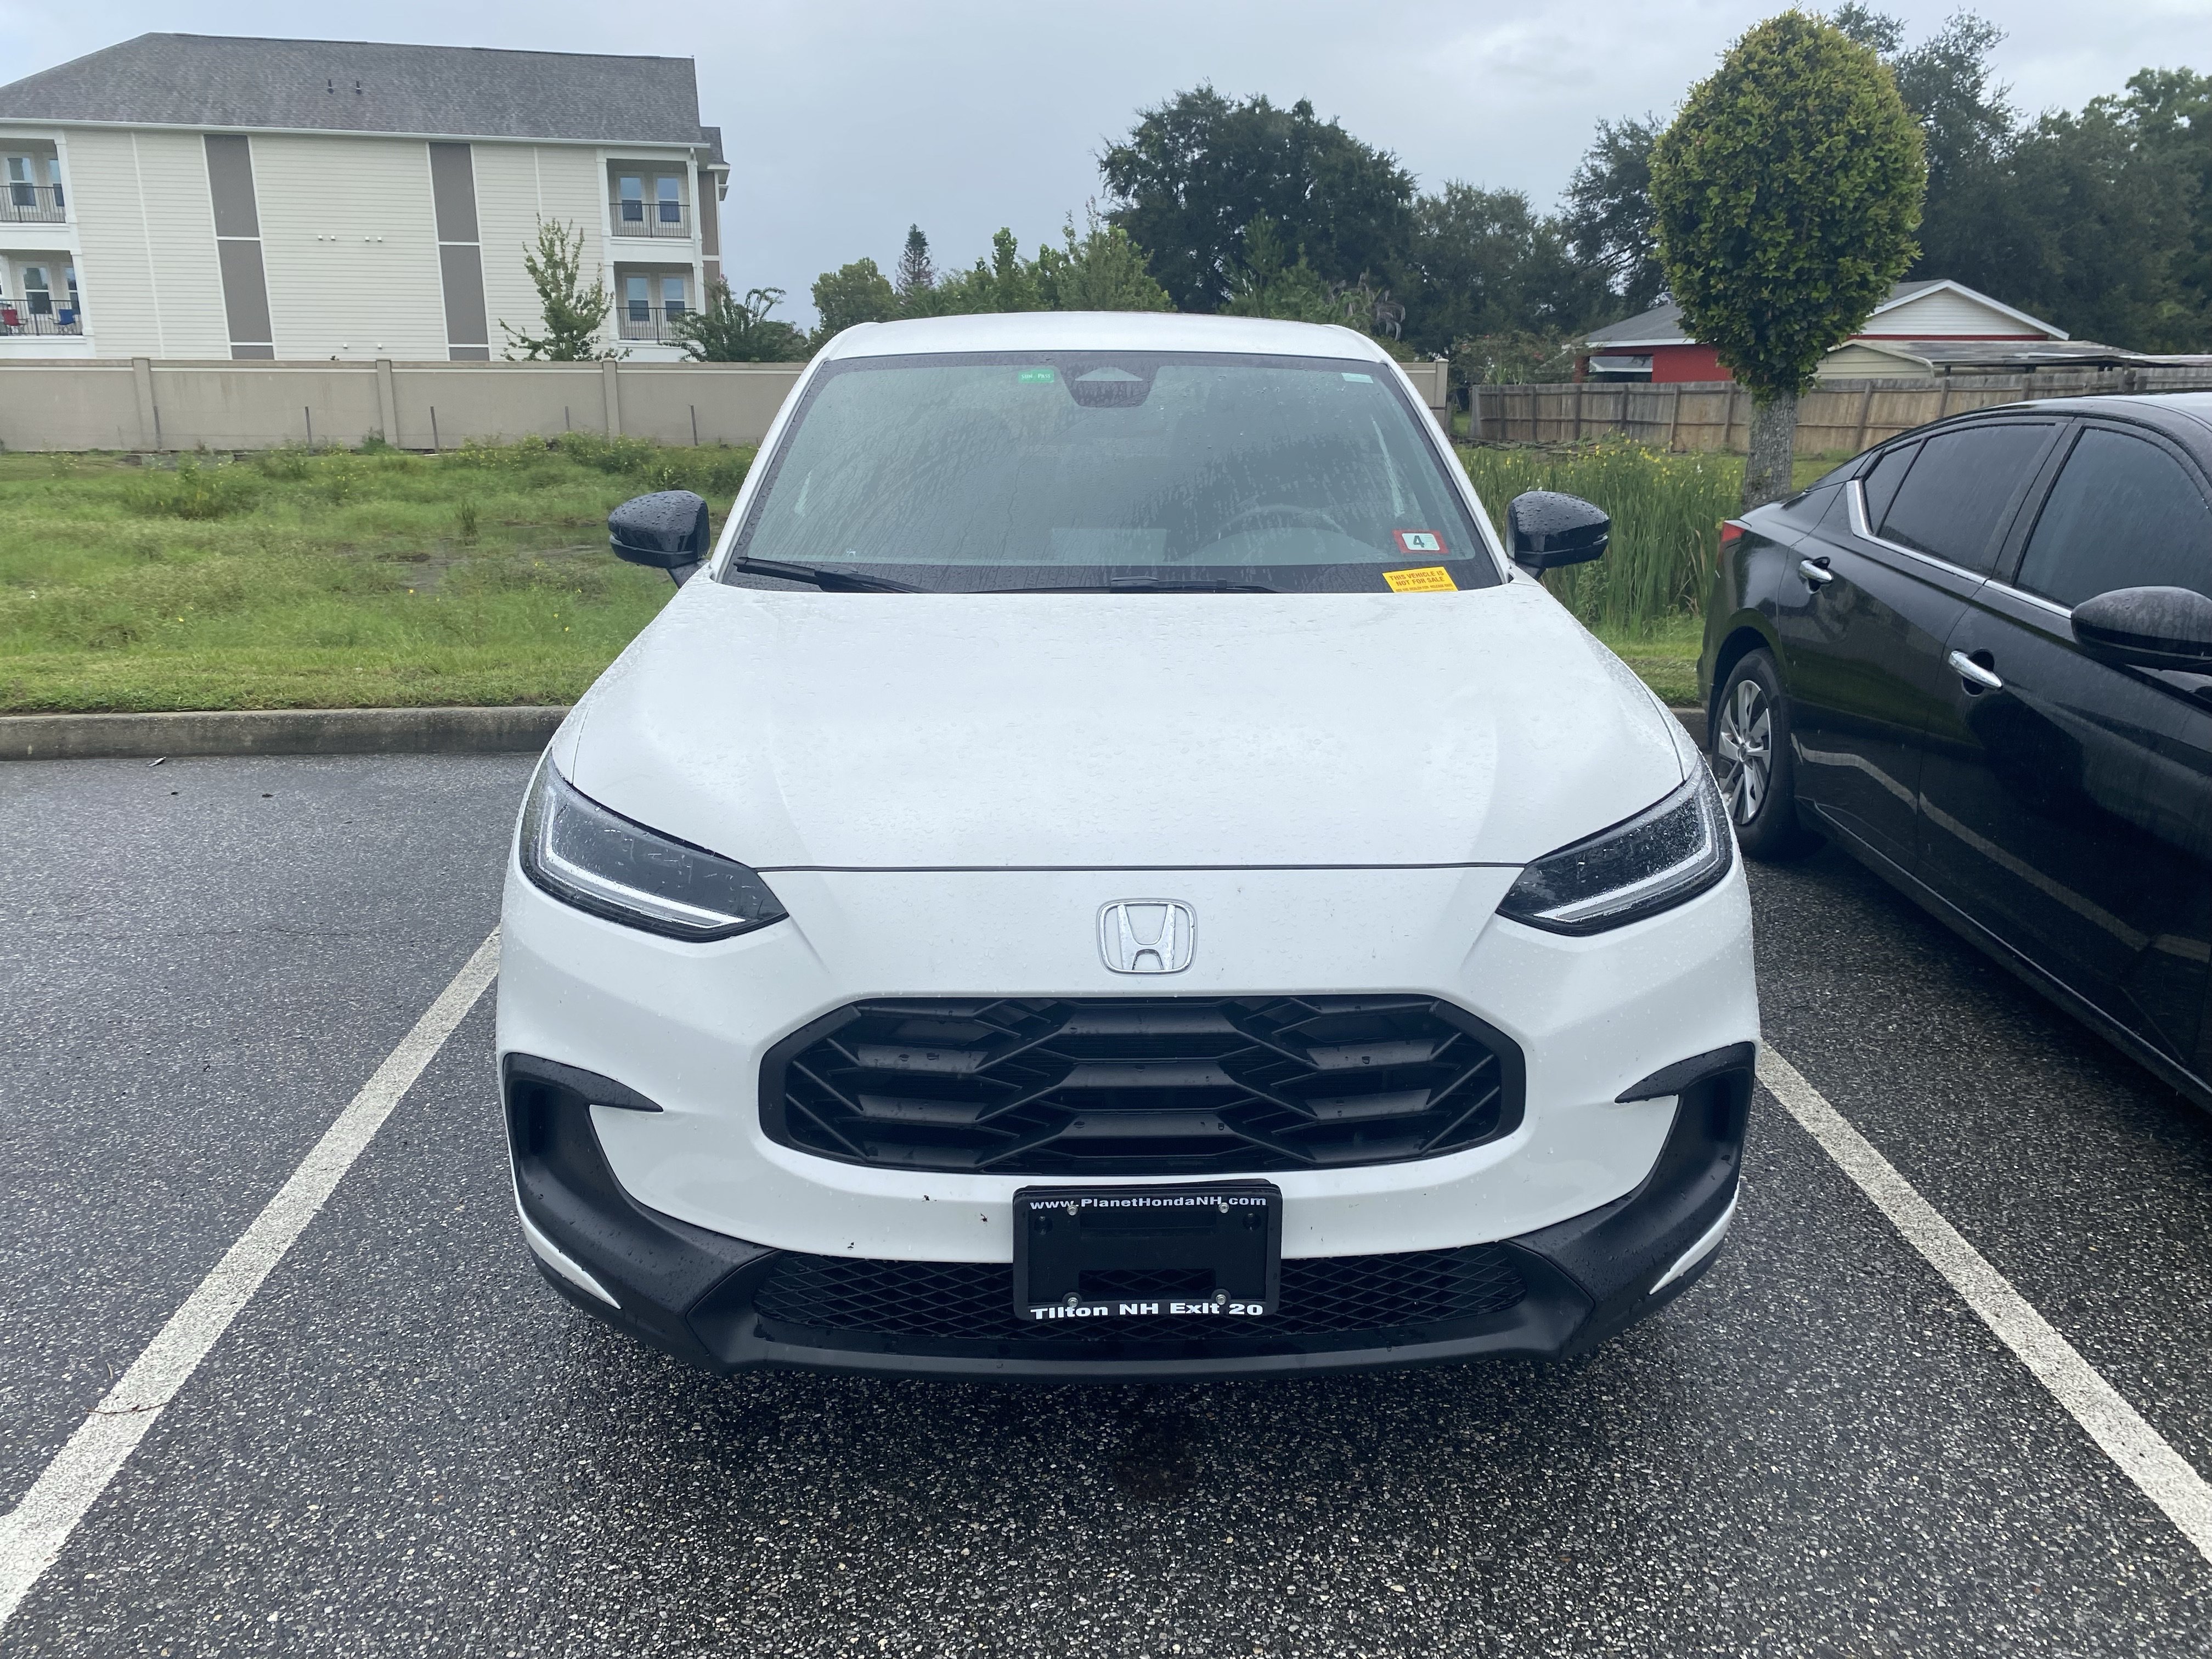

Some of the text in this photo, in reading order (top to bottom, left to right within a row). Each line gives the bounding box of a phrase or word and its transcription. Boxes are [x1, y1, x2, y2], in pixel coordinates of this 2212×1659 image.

[1413, 535, 1425, 548] 4
[1029, 1196, 1267, 1210] www.PlanetHondaNHcom
[1030, 1302, 1263, 1320] Tilton NH Exit 20
